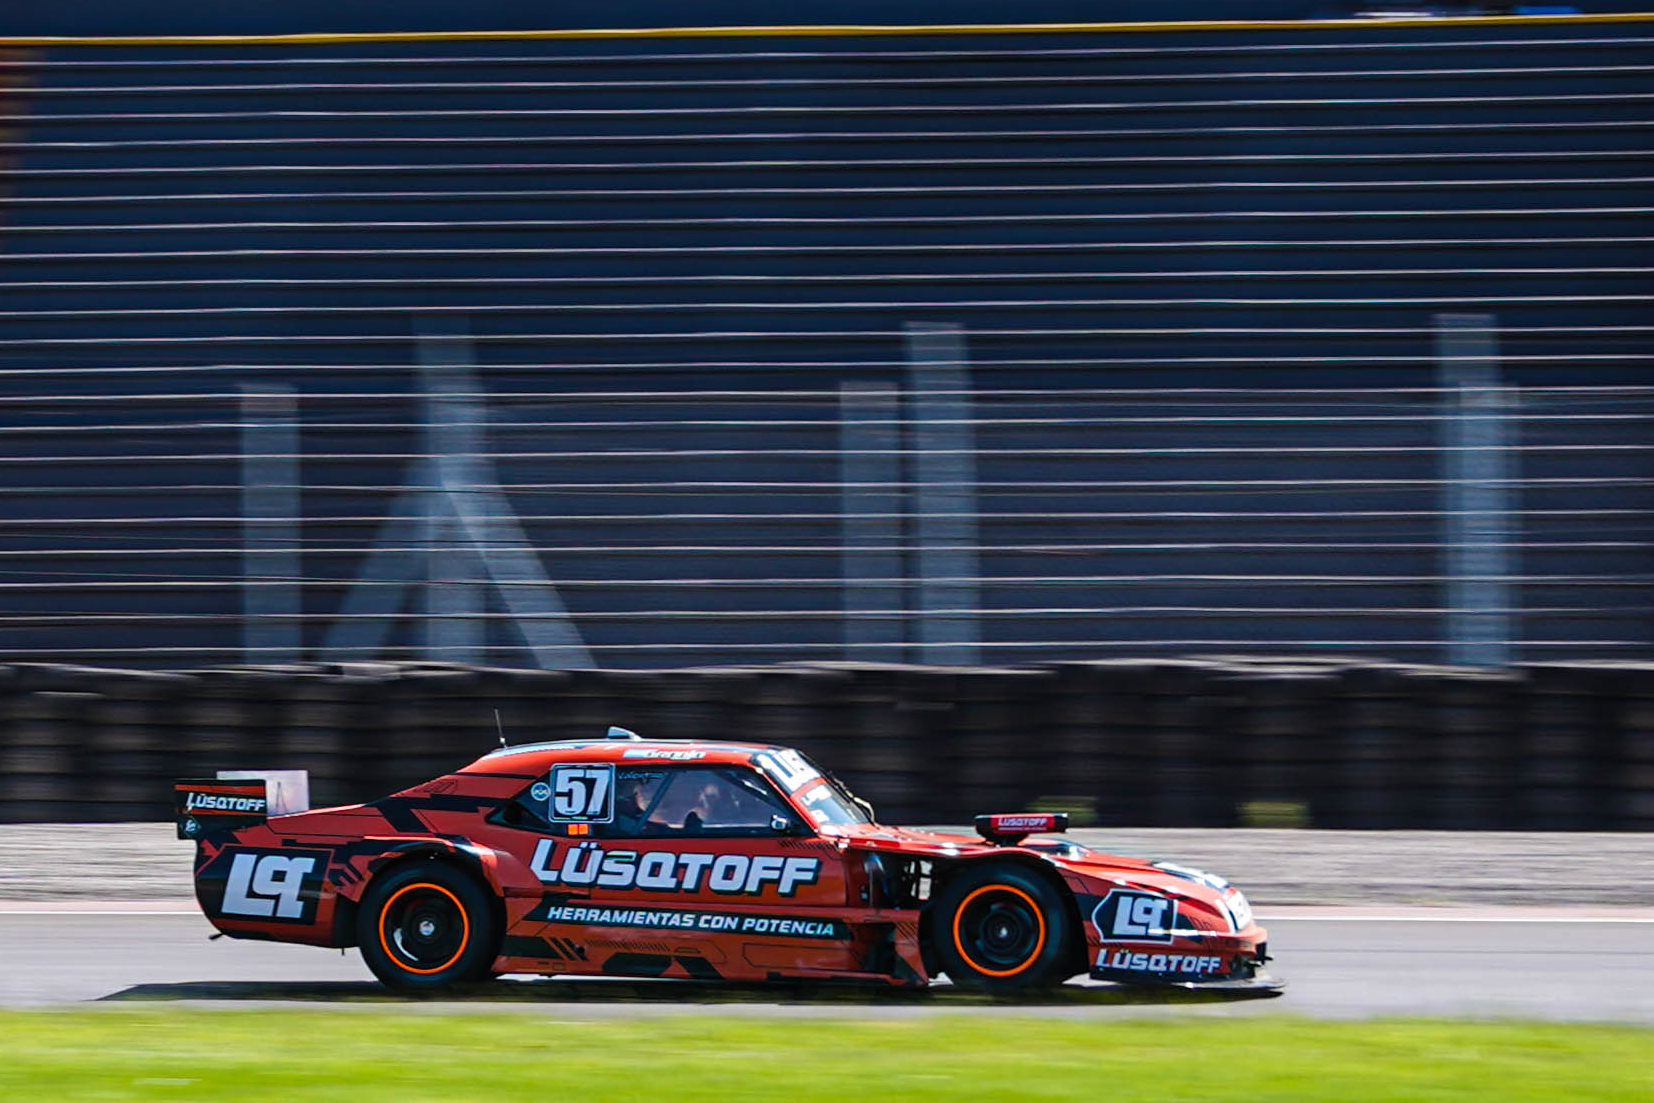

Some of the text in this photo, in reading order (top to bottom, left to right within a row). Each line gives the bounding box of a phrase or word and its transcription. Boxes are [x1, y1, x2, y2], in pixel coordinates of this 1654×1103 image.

[555, 769, 610, 816] 57
[530, 839, 818, 894] LÜSQTOFF
[547, 906, 835, 937] HERRAMIENTAS CON POTENCIA
[1096, 949, 1222, 973] LÜSQTOFF
